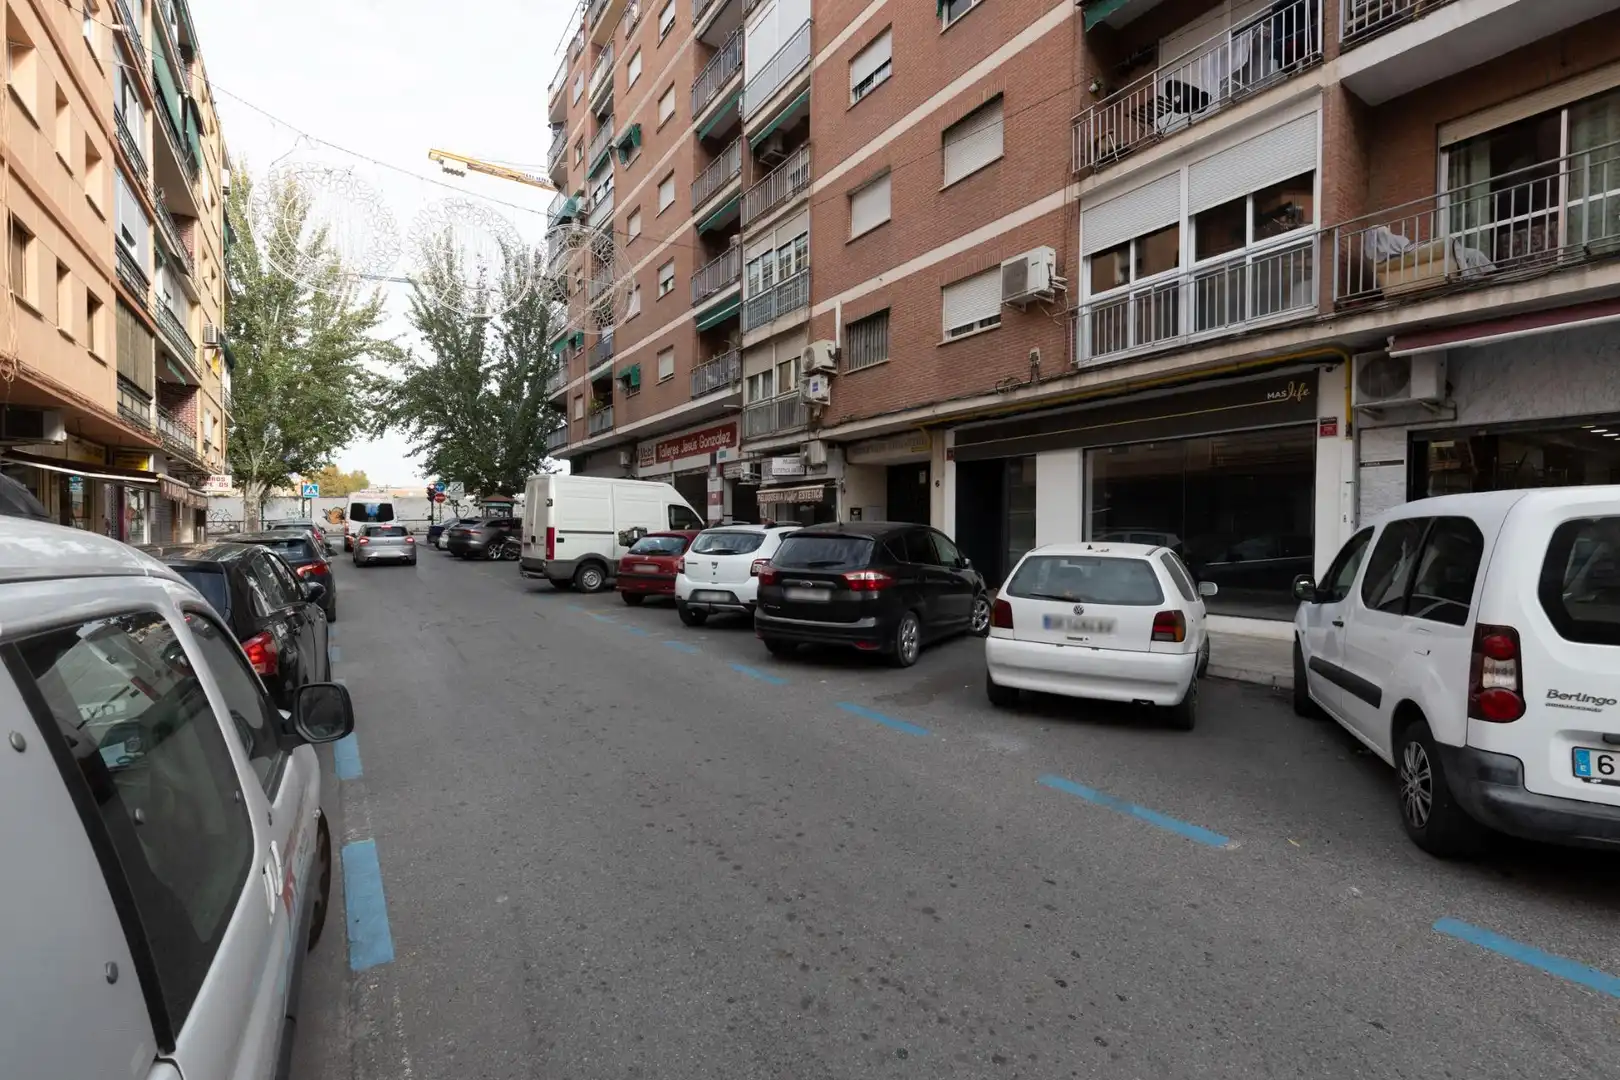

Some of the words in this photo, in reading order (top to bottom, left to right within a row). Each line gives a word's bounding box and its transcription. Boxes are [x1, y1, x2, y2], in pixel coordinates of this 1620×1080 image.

[659, 443, 680, 458] Talleres
[699, 430, 731, 449] González
[1546, 688, 1618, 706] Berlingo
[1597, 754, 1615, 776] 6
